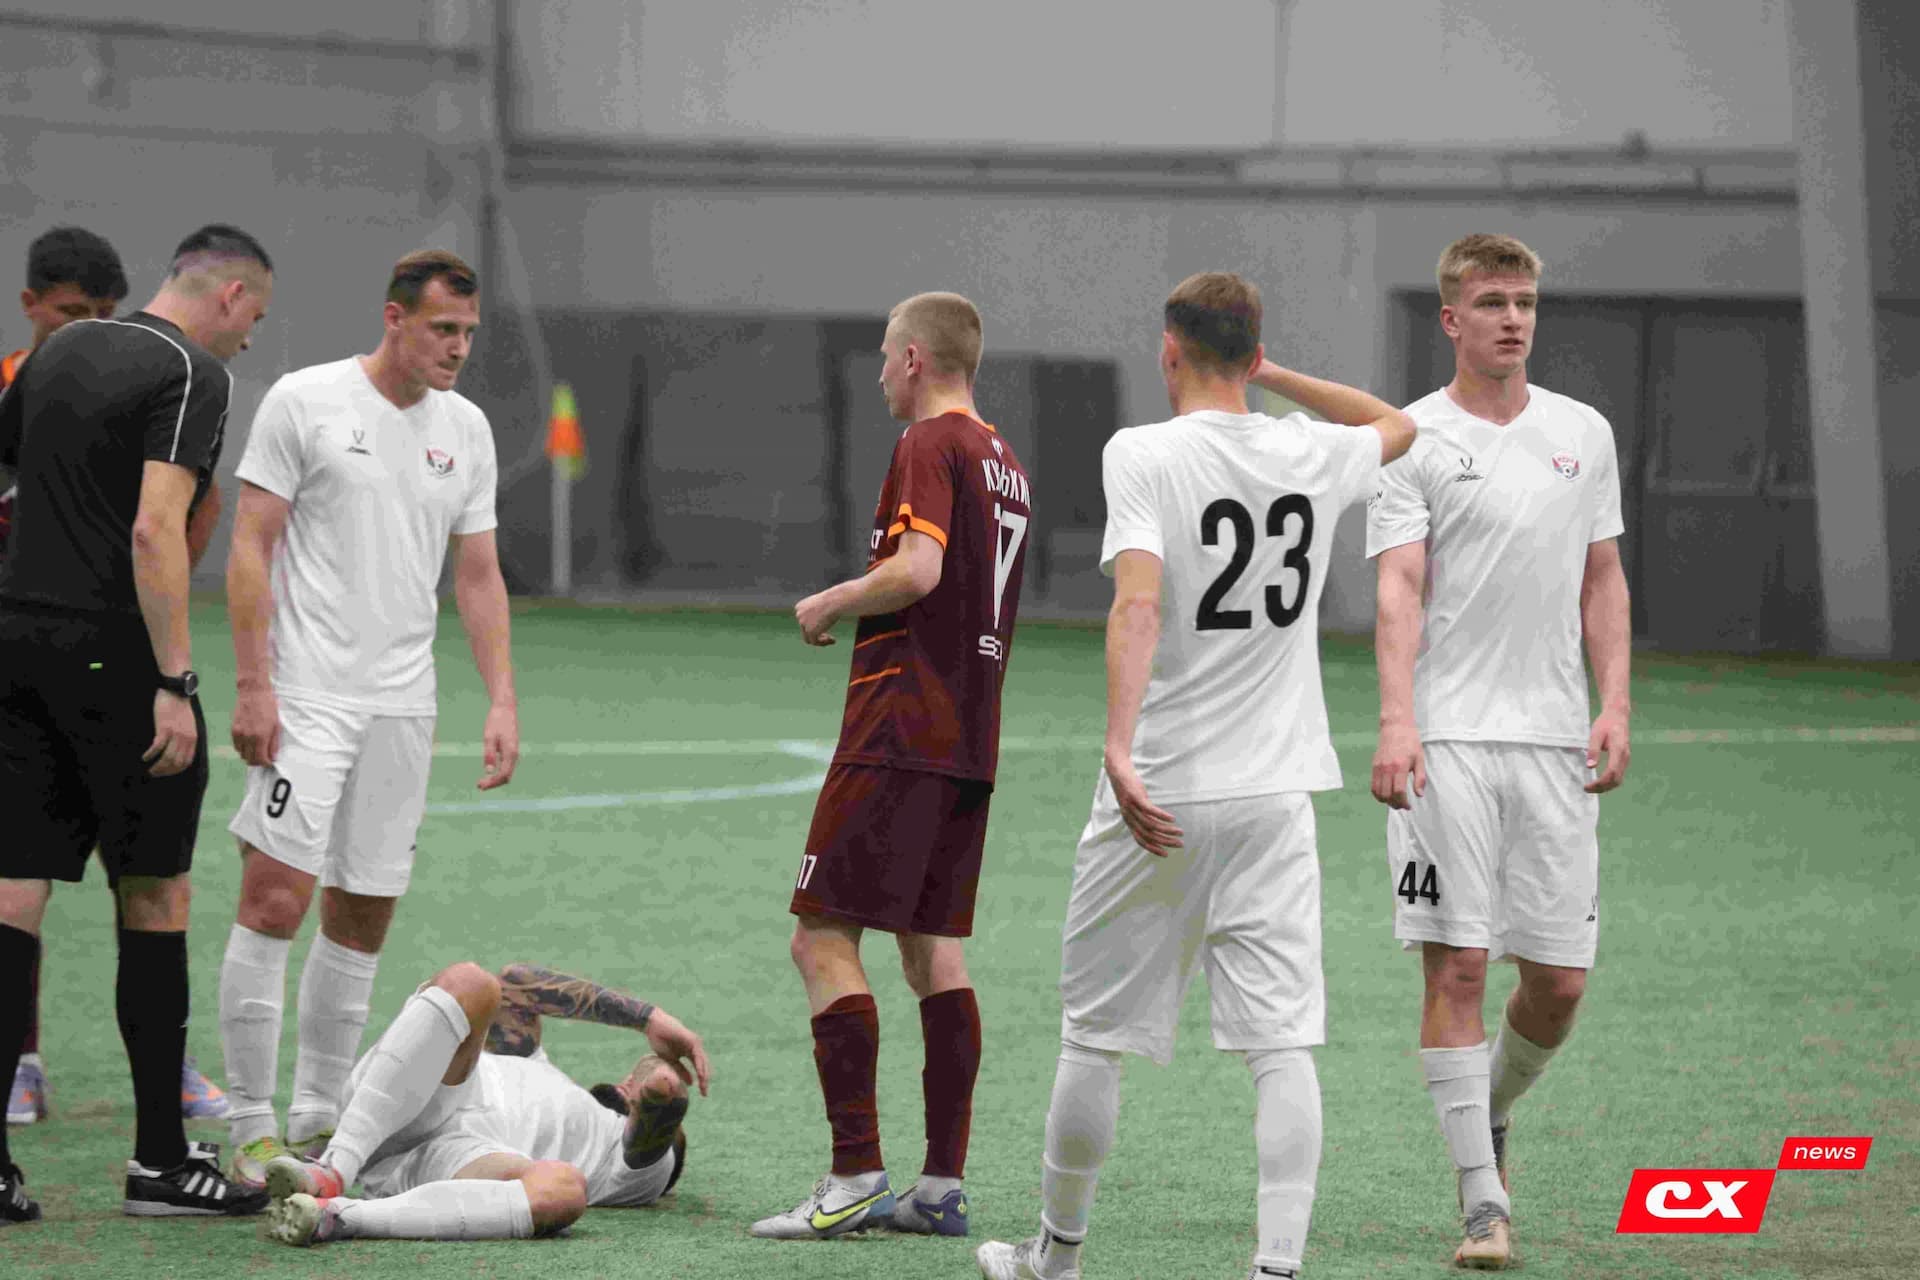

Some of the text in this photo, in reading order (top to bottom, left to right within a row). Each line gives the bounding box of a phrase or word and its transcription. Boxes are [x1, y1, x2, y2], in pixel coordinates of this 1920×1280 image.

[1196, 493, 1314, 631] 23
[267, 778, 291, 818] 9
[797, 854, 817, 890] 17
[1398, 861, 1440, 906] 44
